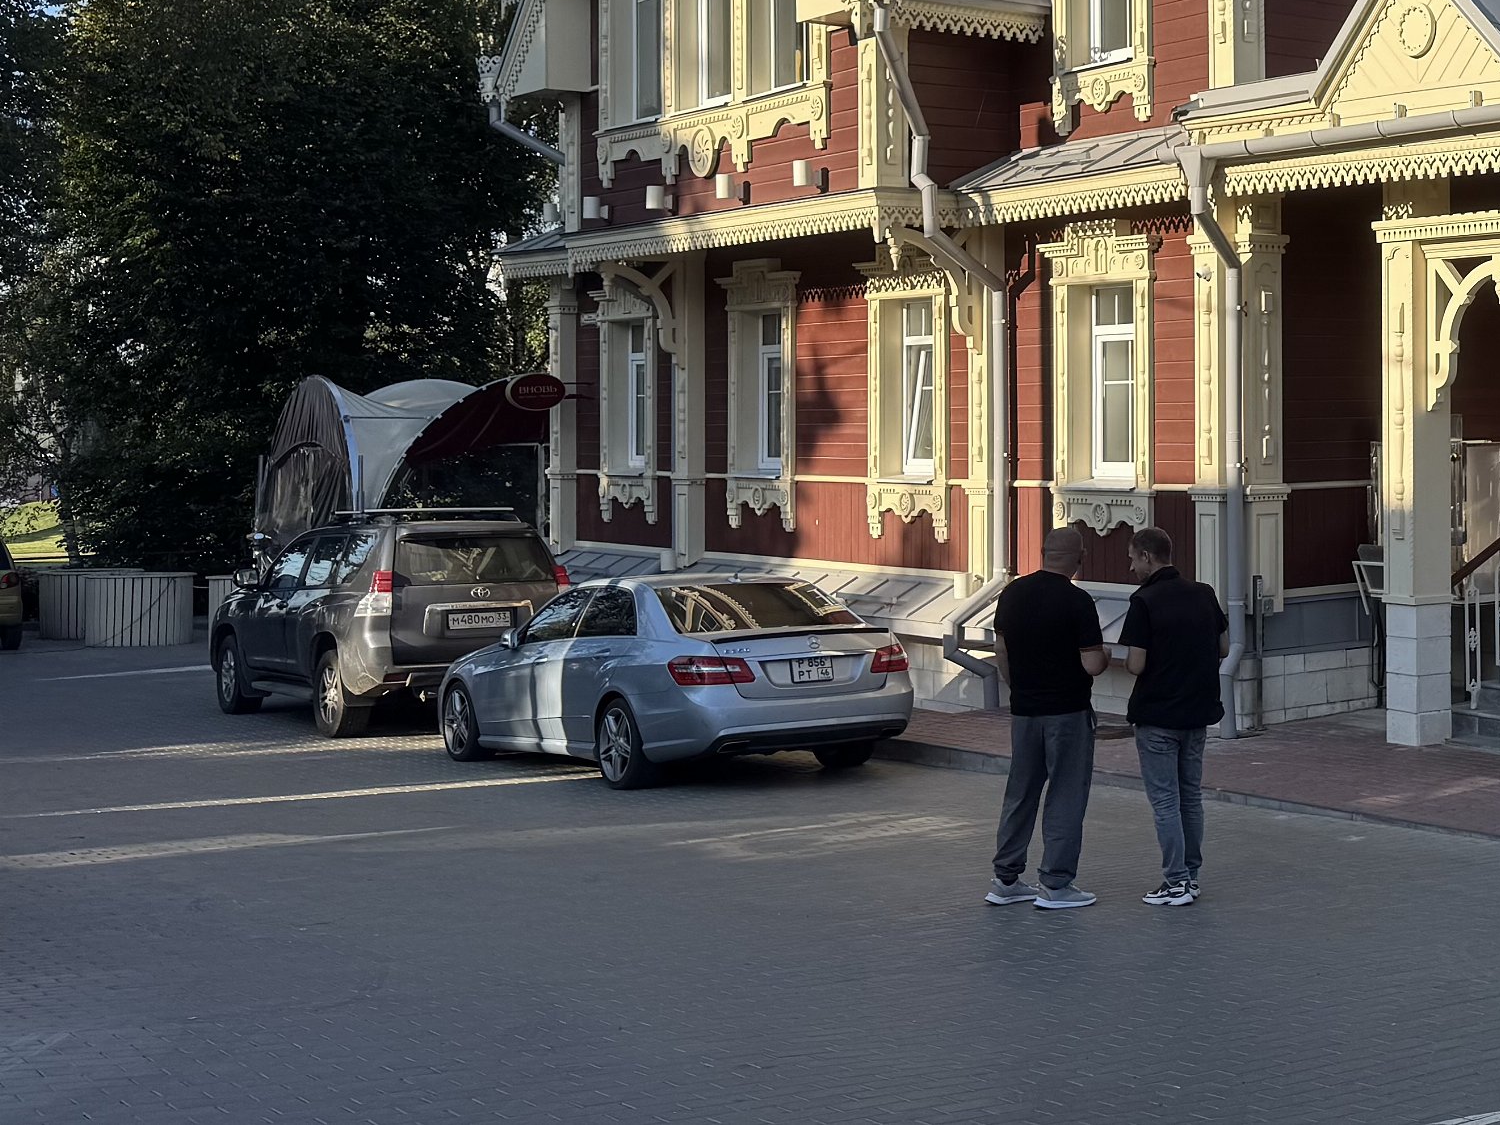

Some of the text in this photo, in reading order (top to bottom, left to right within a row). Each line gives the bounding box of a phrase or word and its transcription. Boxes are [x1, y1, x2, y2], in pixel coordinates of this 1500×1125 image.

[518, 385, 558, 394] ВНОВЬ
[496, 612, 507, 621] 33
[808, 658, 826, 667] 856
[798, 670, 812, 680] РТ
